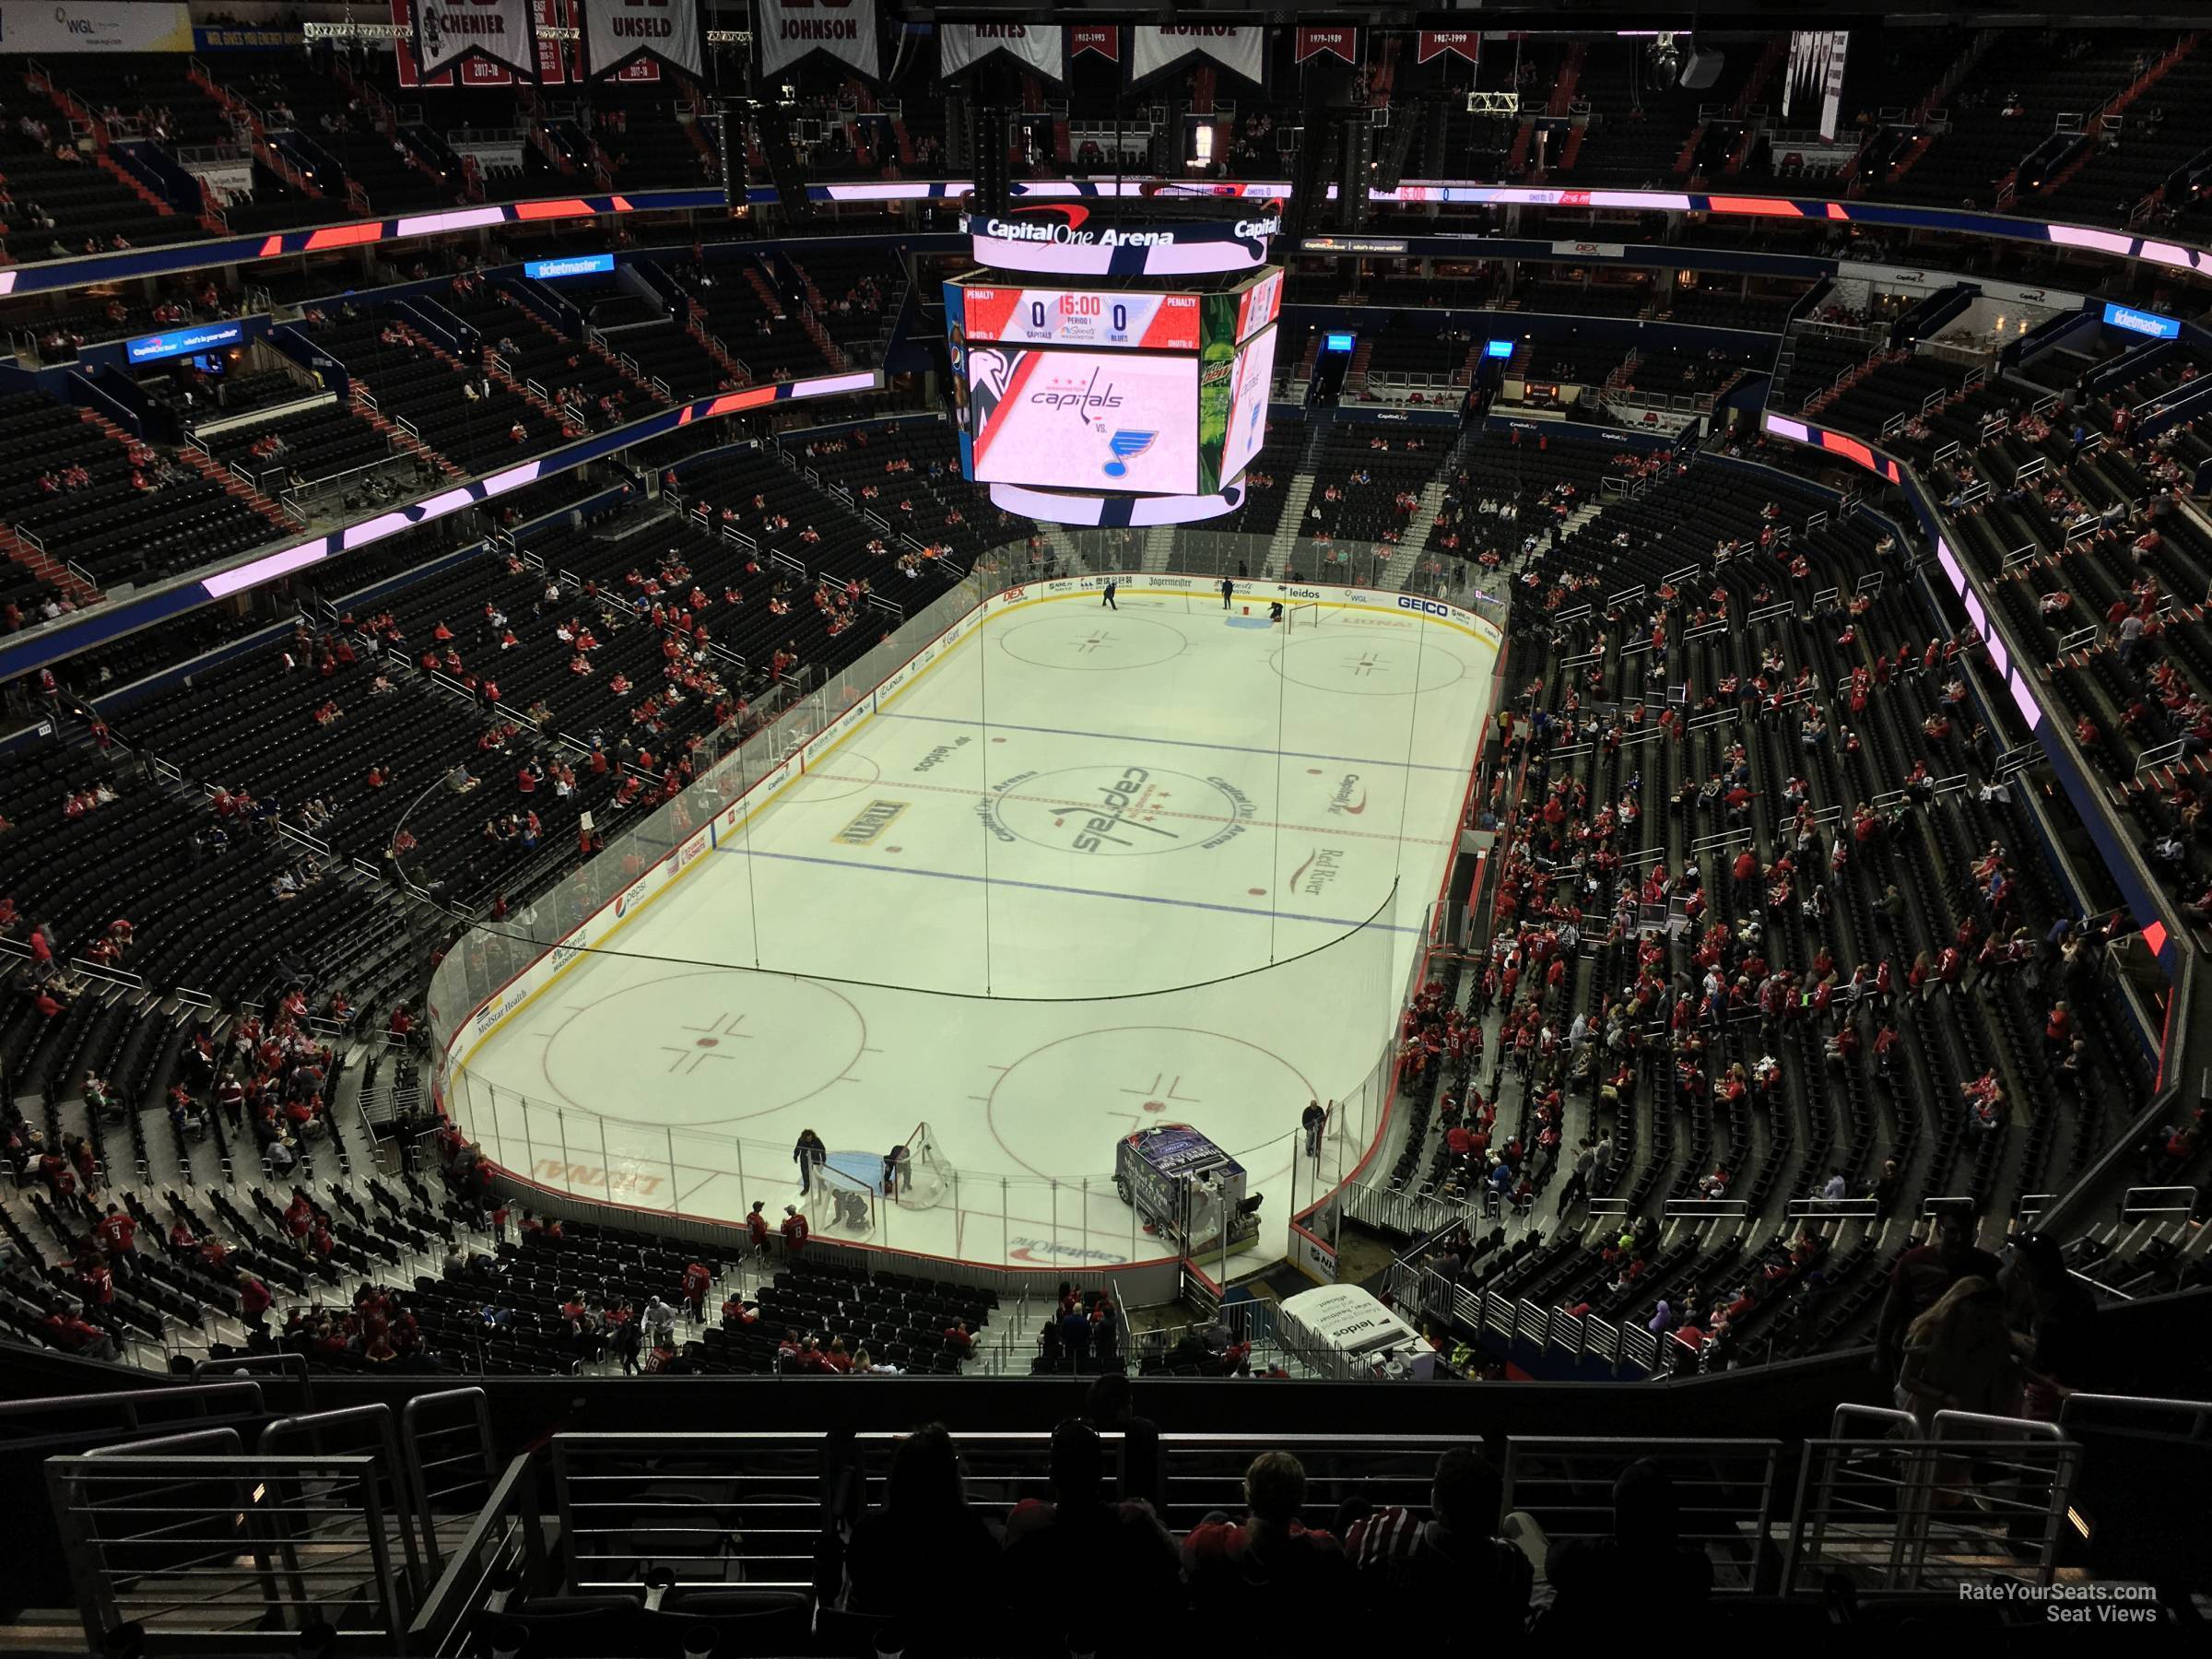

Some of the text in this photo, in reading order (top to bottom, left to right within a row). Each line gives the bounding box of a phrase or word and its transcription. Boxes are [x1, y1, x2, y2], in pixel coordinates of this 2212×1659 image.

[66, 18, 94, 33] WGL
[440, 14, 505, 34] CHENIER
[612, 17, 672, 38] UNSELD
[780, 18, 856, 40] JOHNSON
[975, 24, 1026, 39] HAYES
[1400, 187, 1427, 201] 15:00
[1443, 188, 1450, 201] 0
[1099, 229, 1174, 246] Arena
[539, 260, 598, 276] ticketmaster
[967, 290, 994, 300] PENALTY
[1167, 298, 1196, 307] PENALTY
[1031, 300, 1046, 328] 0
[1059, 295, 1100, 315] 15:00
[1067, 317, 1088, 325] PERIOD
[1113, 304, 1127, 332] 0
[2113, 309, 2164, 335] ticketmaster
[1027, 331, 1052, 339] CAPITALS
[1030, 366, 1124, 425] capitals
[1095, 423, 1107, 433] VS.
[1003, 587, 1026, 602] DEX
[1289, 587, 1321, 599] leidos
[1350, 595, 1368, 604] WGL
[1397, 596, 1448, 618] GEICO
[887, 674, 904, 692] LEXUS
[913, 745, 958, 772] leidos
[992, 770, 1039, 793] Arena
[1060, 767, 1166, 853] capitals
[1201, 824, 1247, 851] Arena
[1304, 848, 1345, 896] Red River
[626, 880, 646, 902] pepsi
[477, 989, 528, 1035] MedStar Health
[1157, 1159, 1177, 1171] Son
[1154, 1185, 1169, 1206] Son
[795, 1226, 803, 1239] 8
[688, 1276, 696, 1289] 8
[1333, 1319, 1375, 1337] leidos
